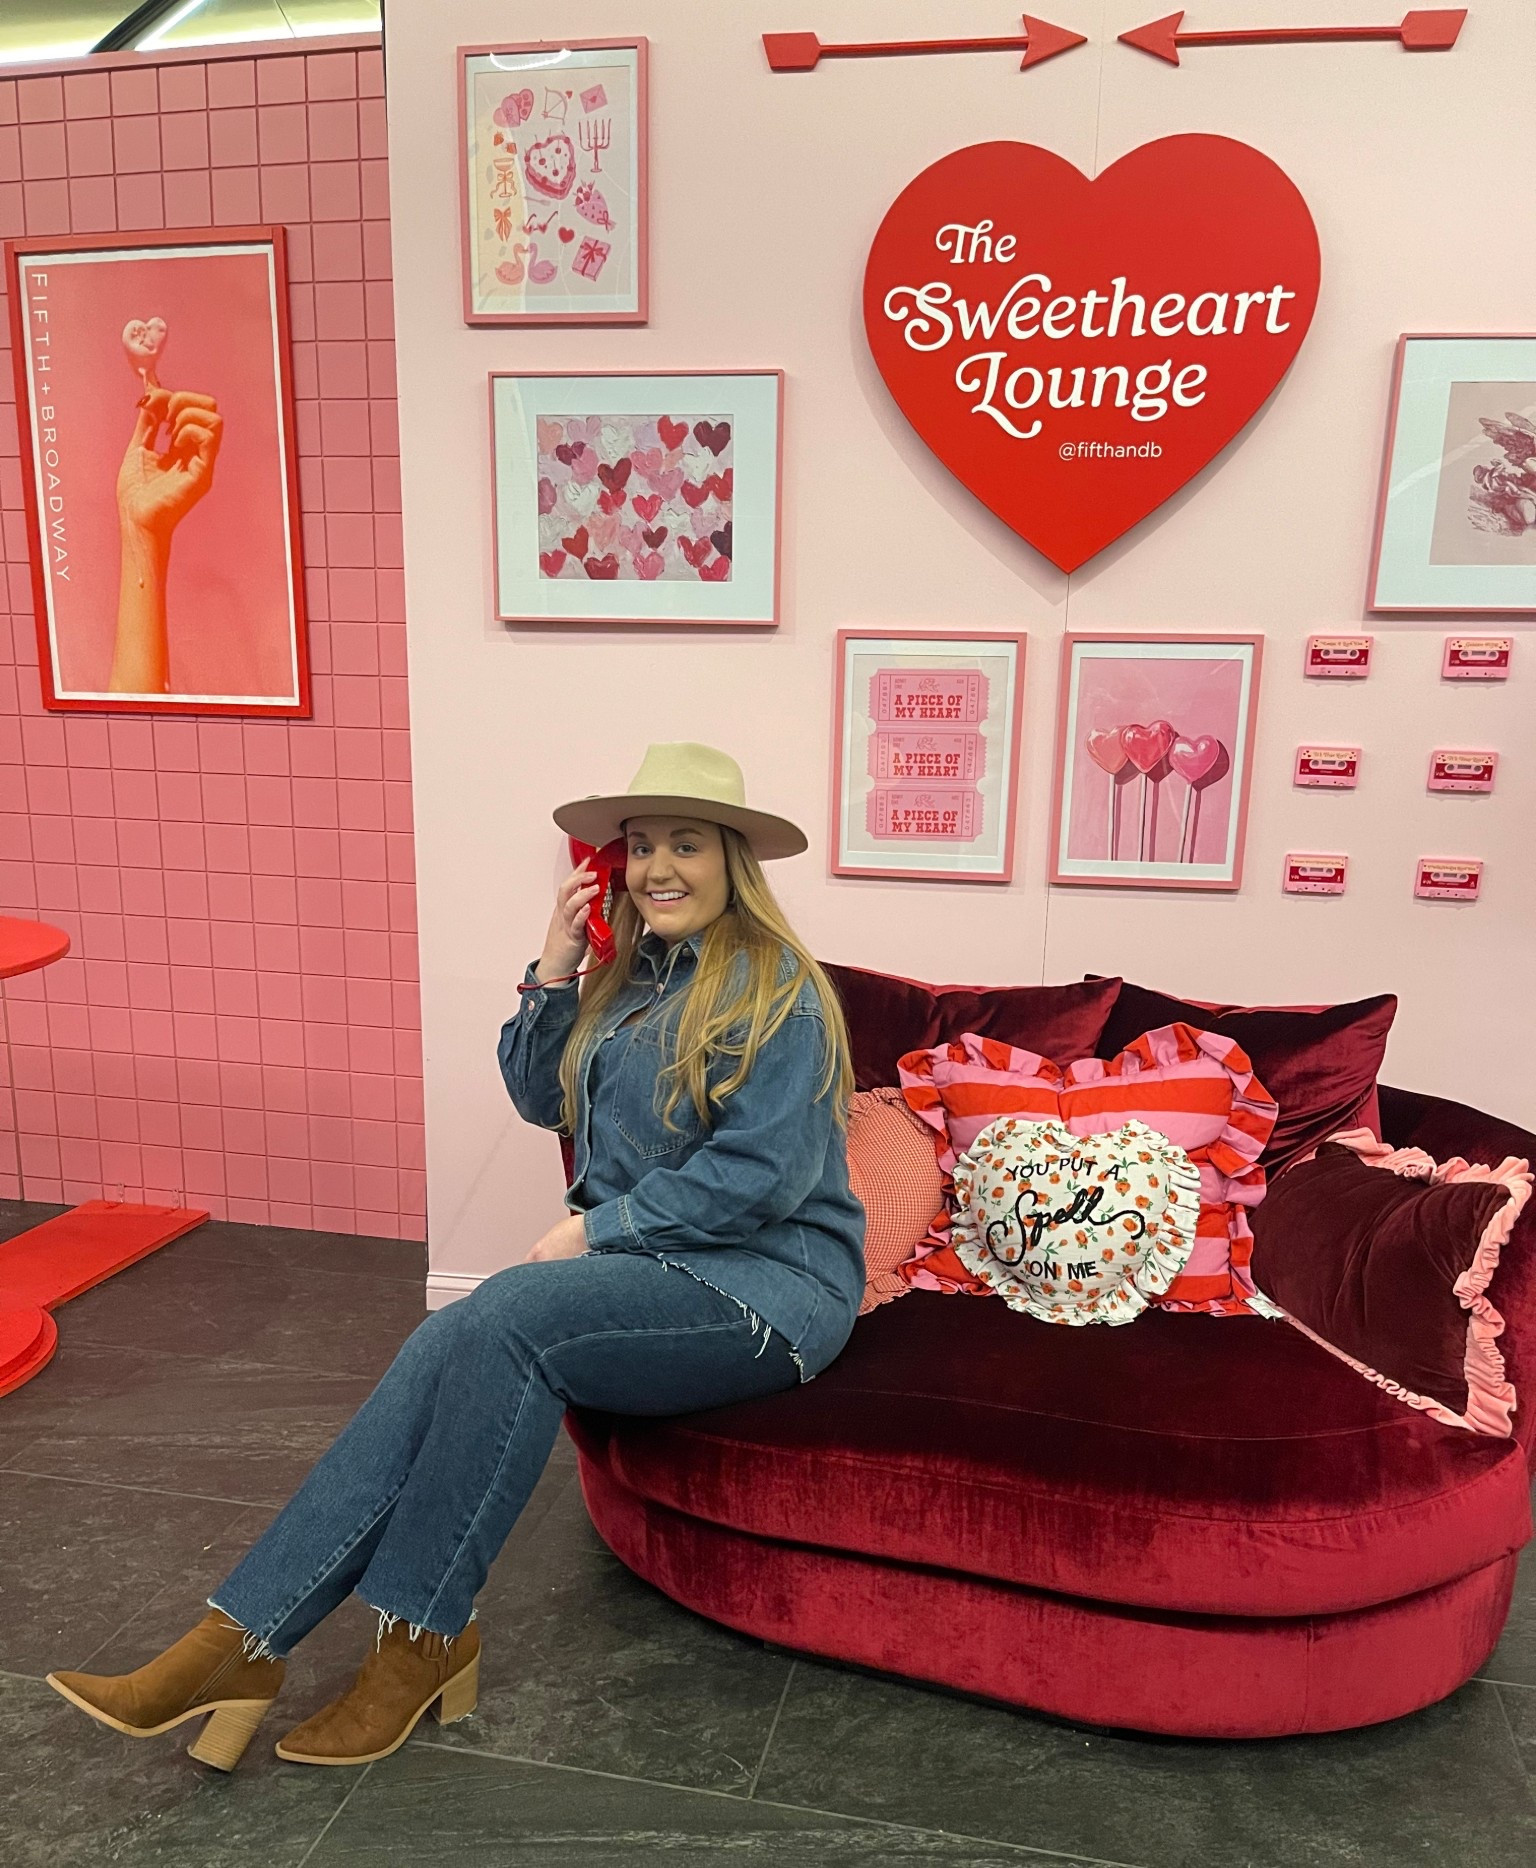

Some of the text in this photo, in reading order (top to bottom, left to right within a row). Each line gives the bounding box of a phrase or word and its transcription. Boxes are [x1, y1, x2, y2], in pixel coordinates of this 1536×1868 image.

[935, 219, 1017, 265] The
[31, 273, 52, 372] FIFTH
[883, 273, 1296, 352] Sweetheart
[954, 351, 1209, 439] Lounge
[1057, 441, 1163, 460] @fifthandb
[41, 406, 71, 583] BROADWAY
[894, 694, 963, 706] A PIECE OF
[895, 707, 962, 719] MY HEART
[892, 752, 961, 765] A PIECE OF
[893, 765, 959, 777] MY HEART
[890, 809, 959, 822] A PIECE OF
[891, 821, 957, 834] MY HEART
[1005, 1157, 1122, 1181] YOU PUT A
[985, 1185, 1146, 1266] Spell
[1029, 1260, 1099, 1280] ON ME
